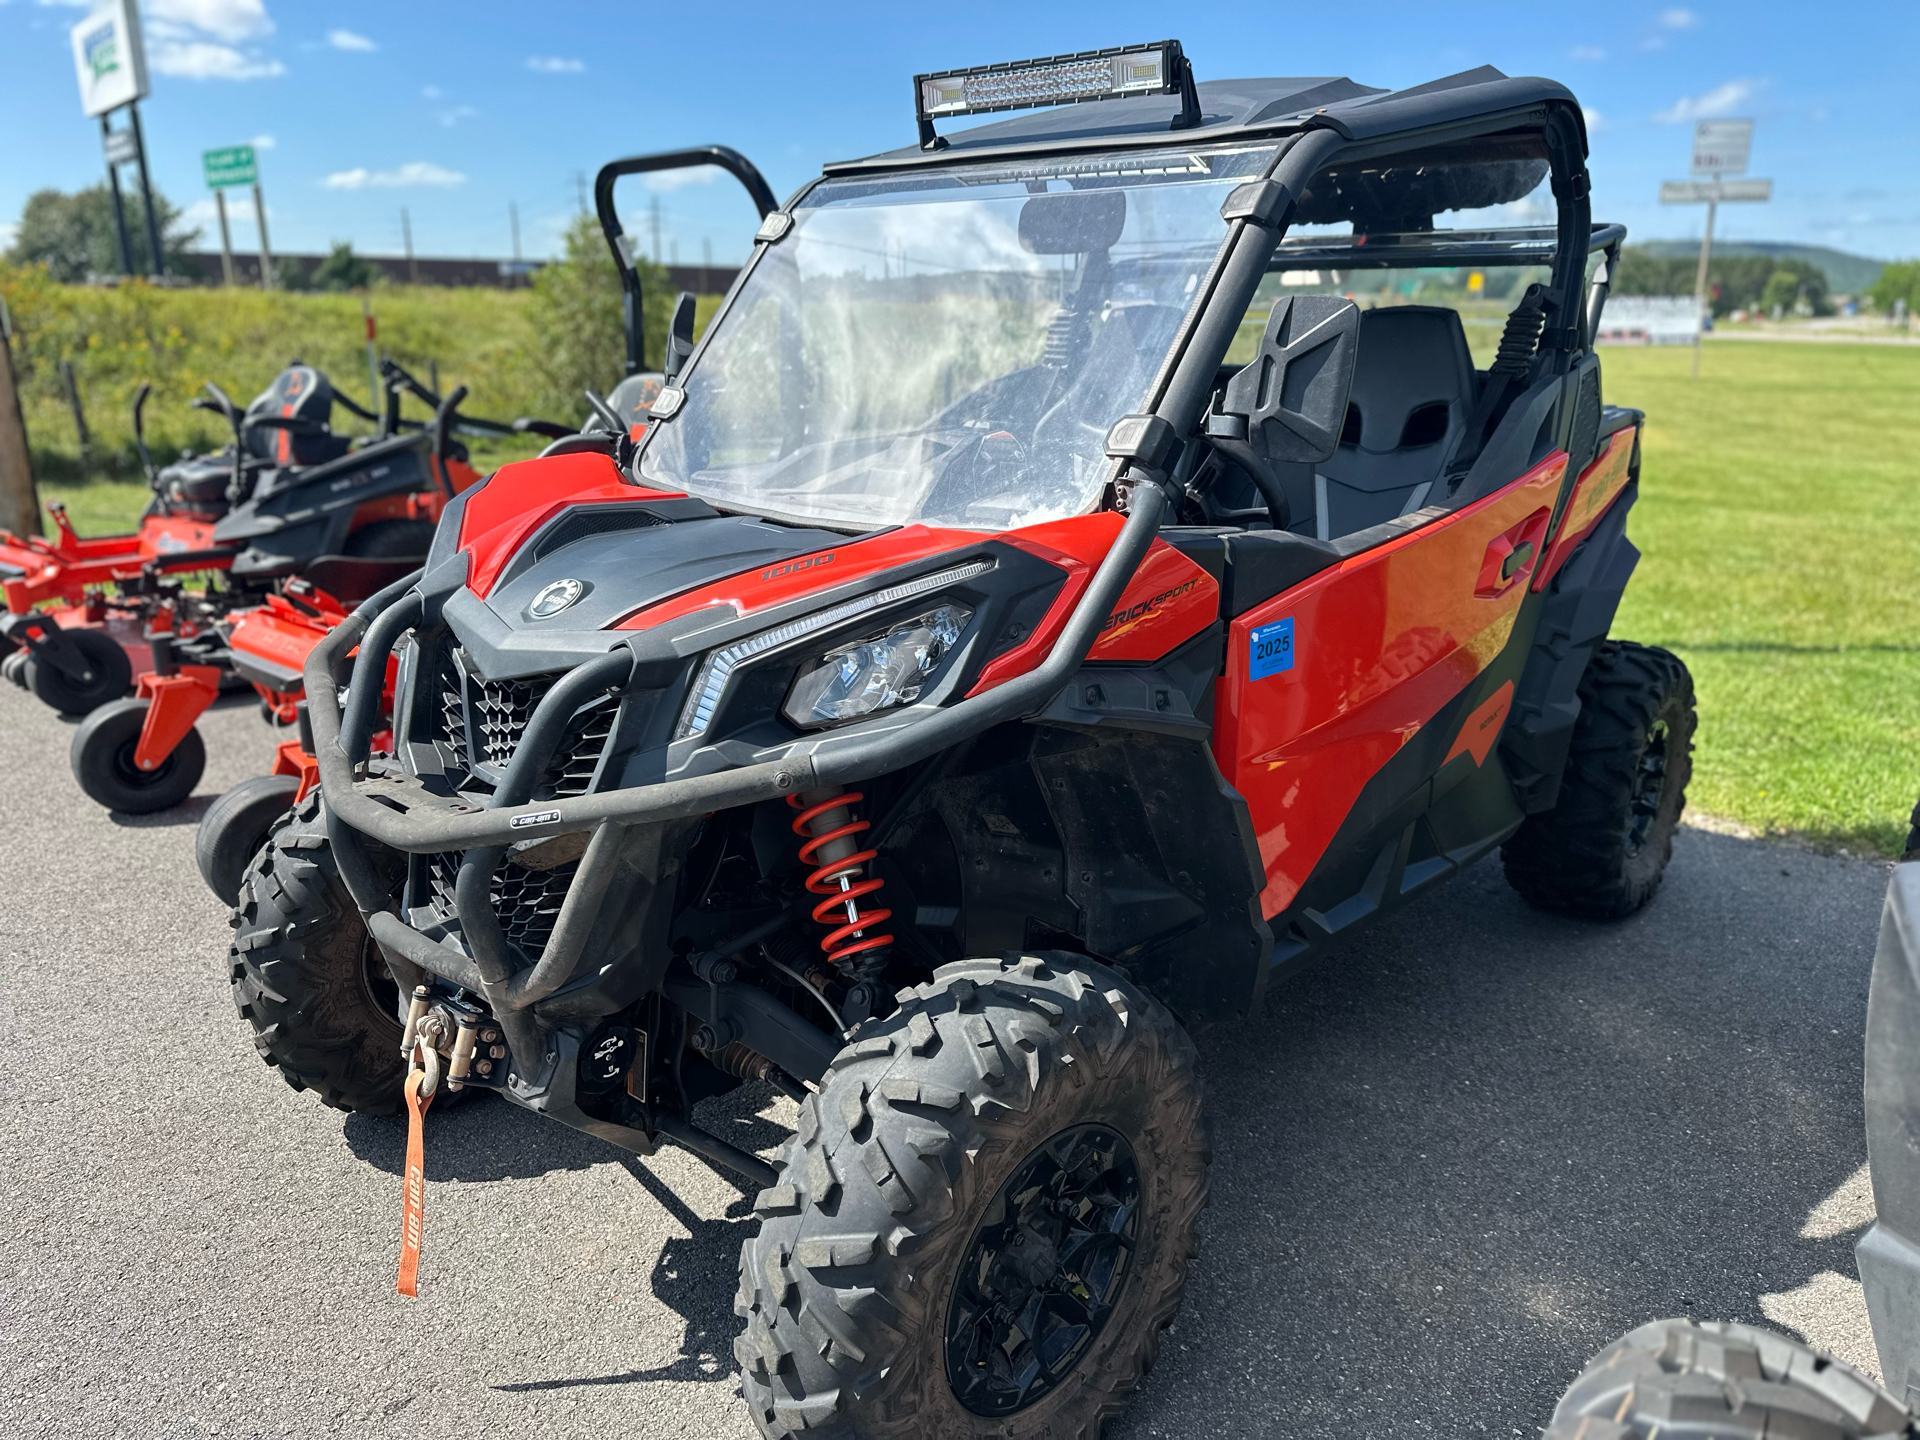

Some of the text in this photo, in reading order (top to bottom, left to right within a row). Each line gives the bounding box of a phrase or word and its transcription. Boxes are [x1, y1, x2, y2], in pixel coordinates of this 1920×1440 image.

[762, 553, 835, 581] 1000
[544, 594, 568, 605] BRP
[1153, 578, 1199, 607] SPORT
[1256, 635, 1290, 661] 2025
[407, 1163, 421, 1252] can-am
